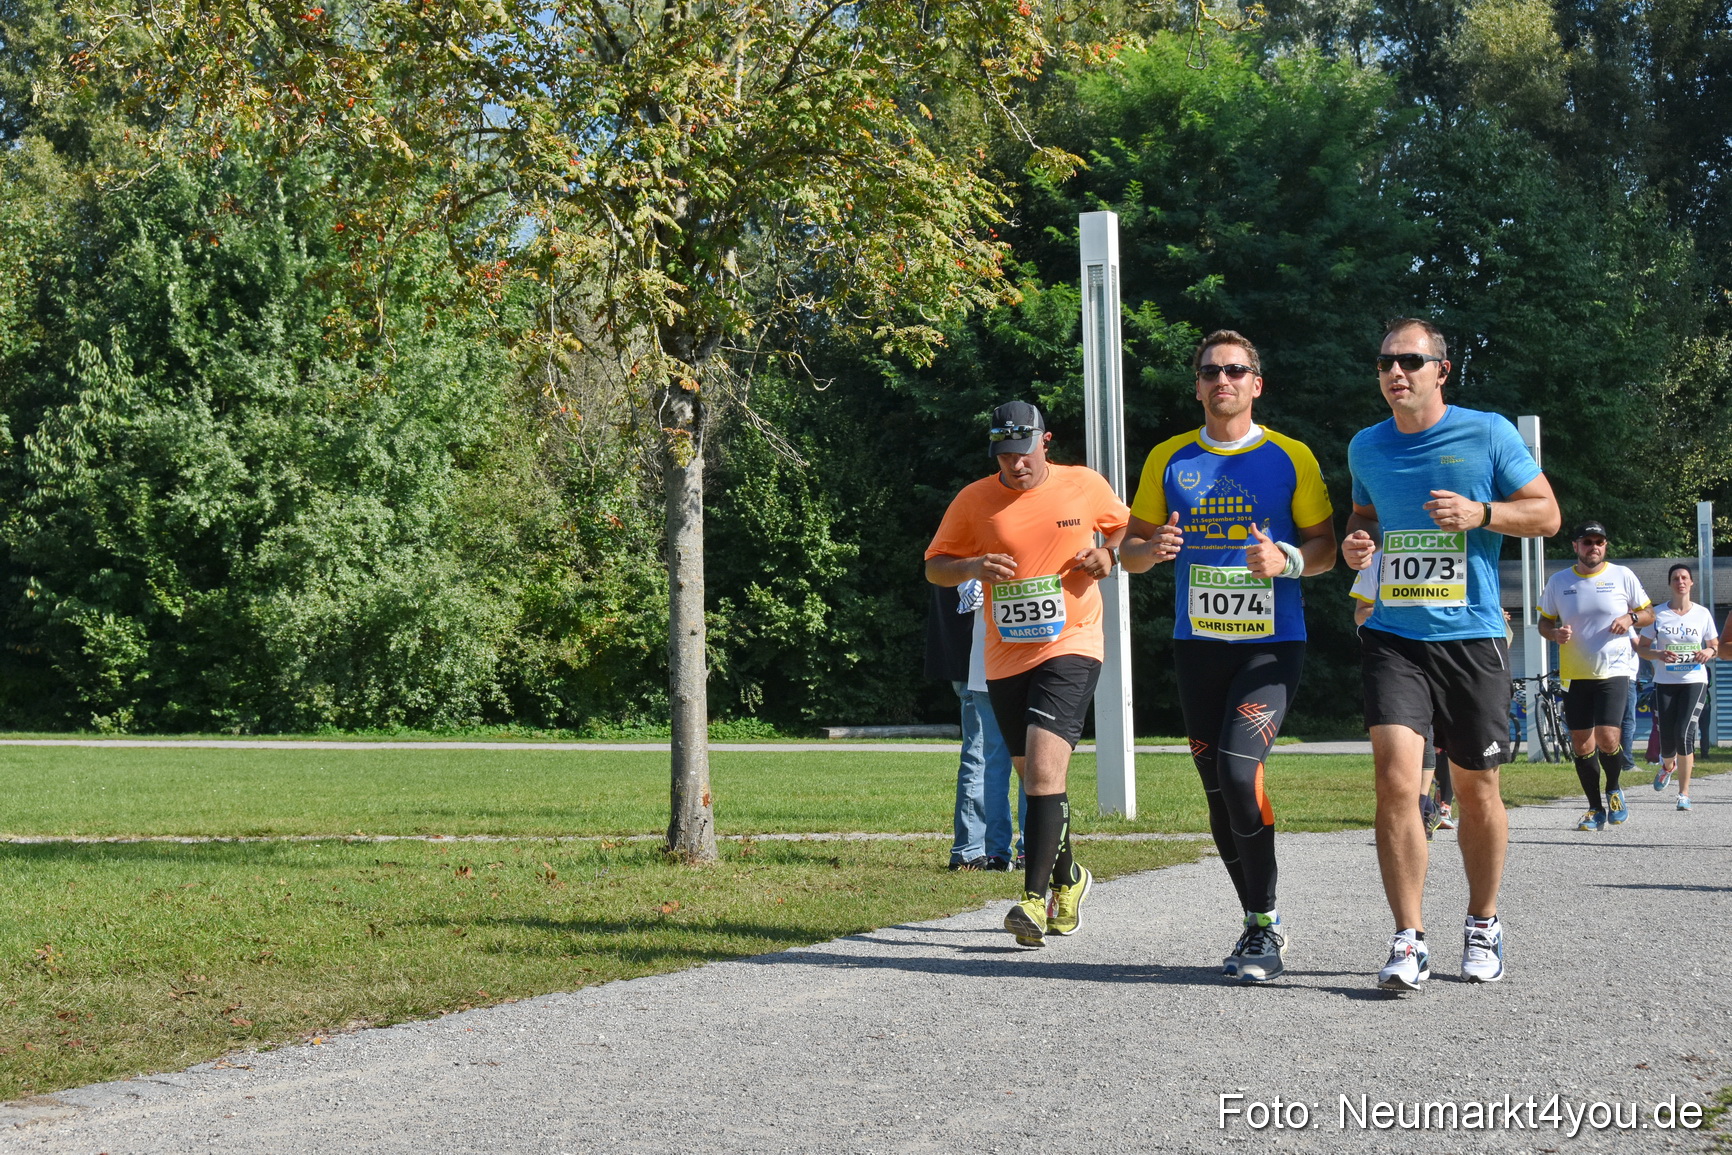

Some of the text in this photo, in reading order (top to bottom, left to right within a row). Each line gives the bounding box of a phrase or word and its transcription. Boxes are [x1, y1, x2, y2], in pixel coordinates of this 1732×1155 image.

[1056, 519, 1081, 528] THULE
[1389, 535, 1456, 550] BOCK
[1390, 557, 1455, 580] 1073
[1197, 570, 1262, 585] BOCK
[997, 579, 1053, 598] BOCK
[1392, 587, 1449, 597] DOMINIC
[1198, 592, 1264, 615] 1074
[1000, 599, 1057, 624] 2539
[1009, 625, 1055, 637] MARCOS
[1198, 620, 1265, 632] CHRISTIAN
[1671, 653, 1697, 664] 527
